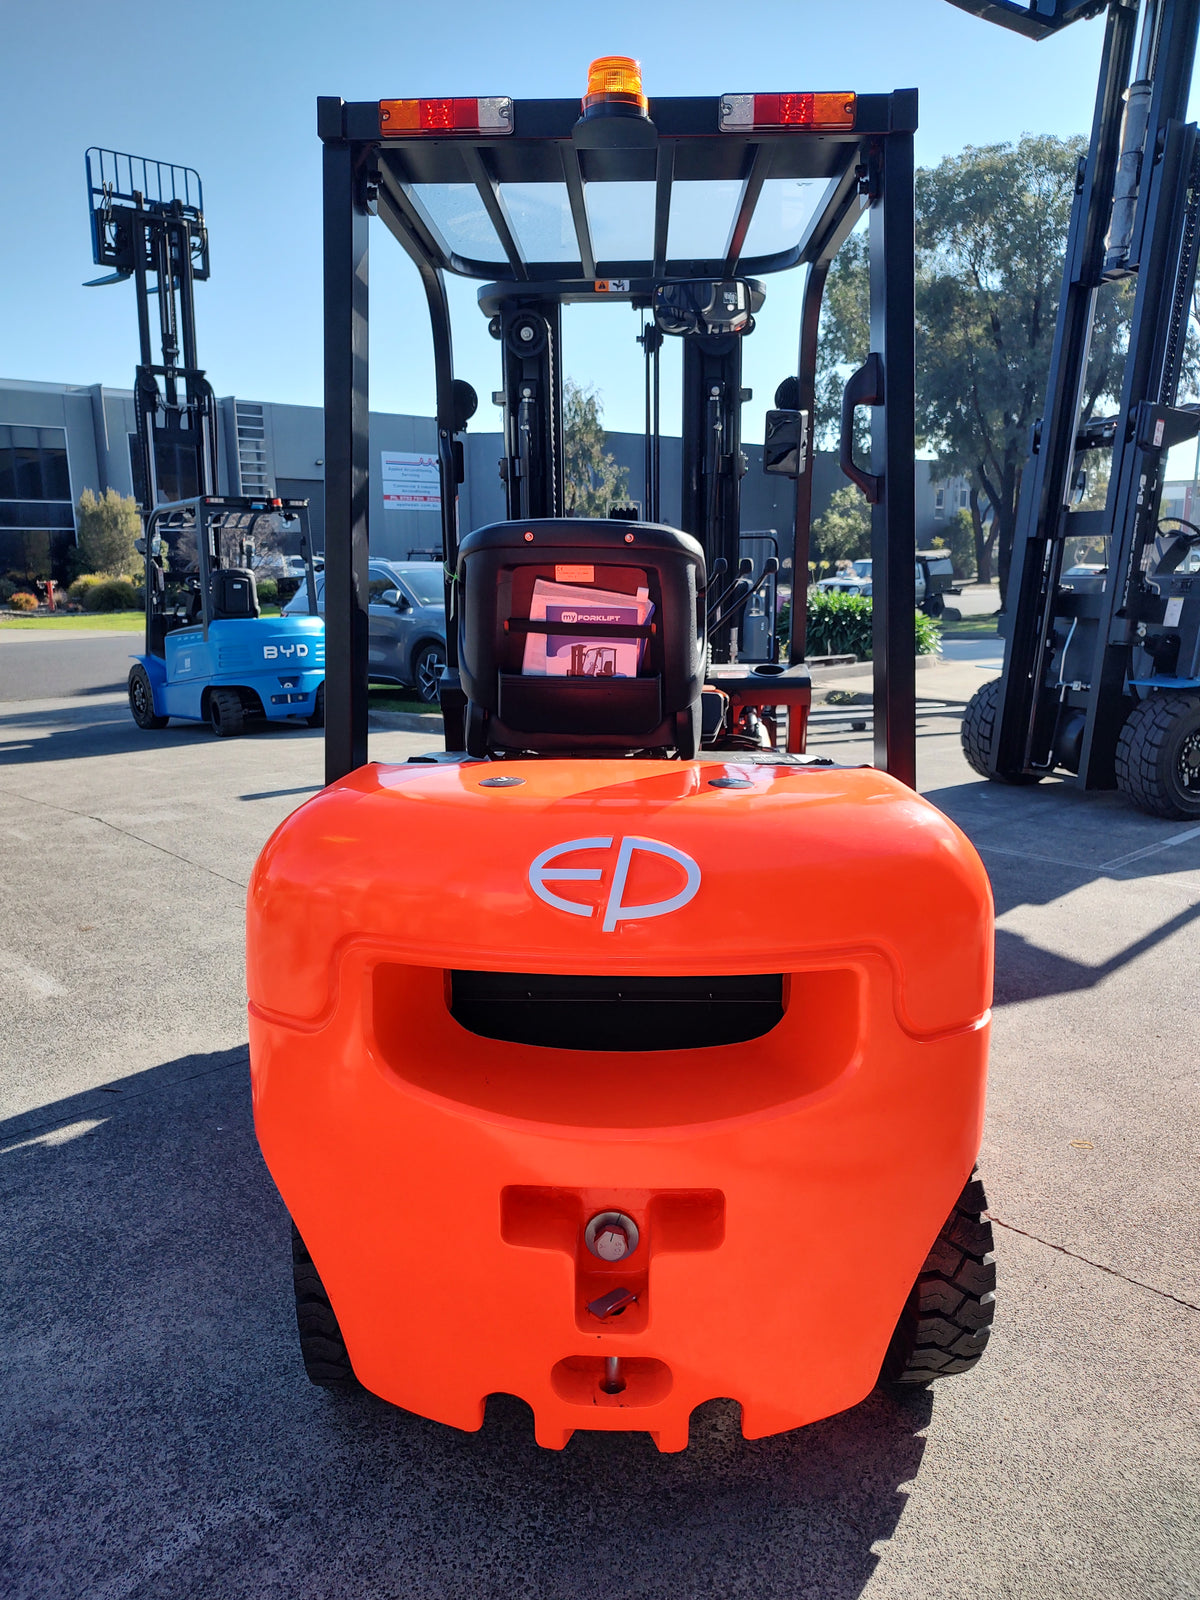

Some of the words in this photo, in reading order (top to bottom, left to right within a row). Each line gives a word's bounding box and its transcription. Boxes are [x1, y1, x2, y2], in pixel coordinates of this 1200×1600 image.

[1136, 474, 1147, 505] BYD
[577, 614, 621, 622] FORKLIFT
[263, 643, 309, 660] BYD
[528, 835, 702, 933] EP
